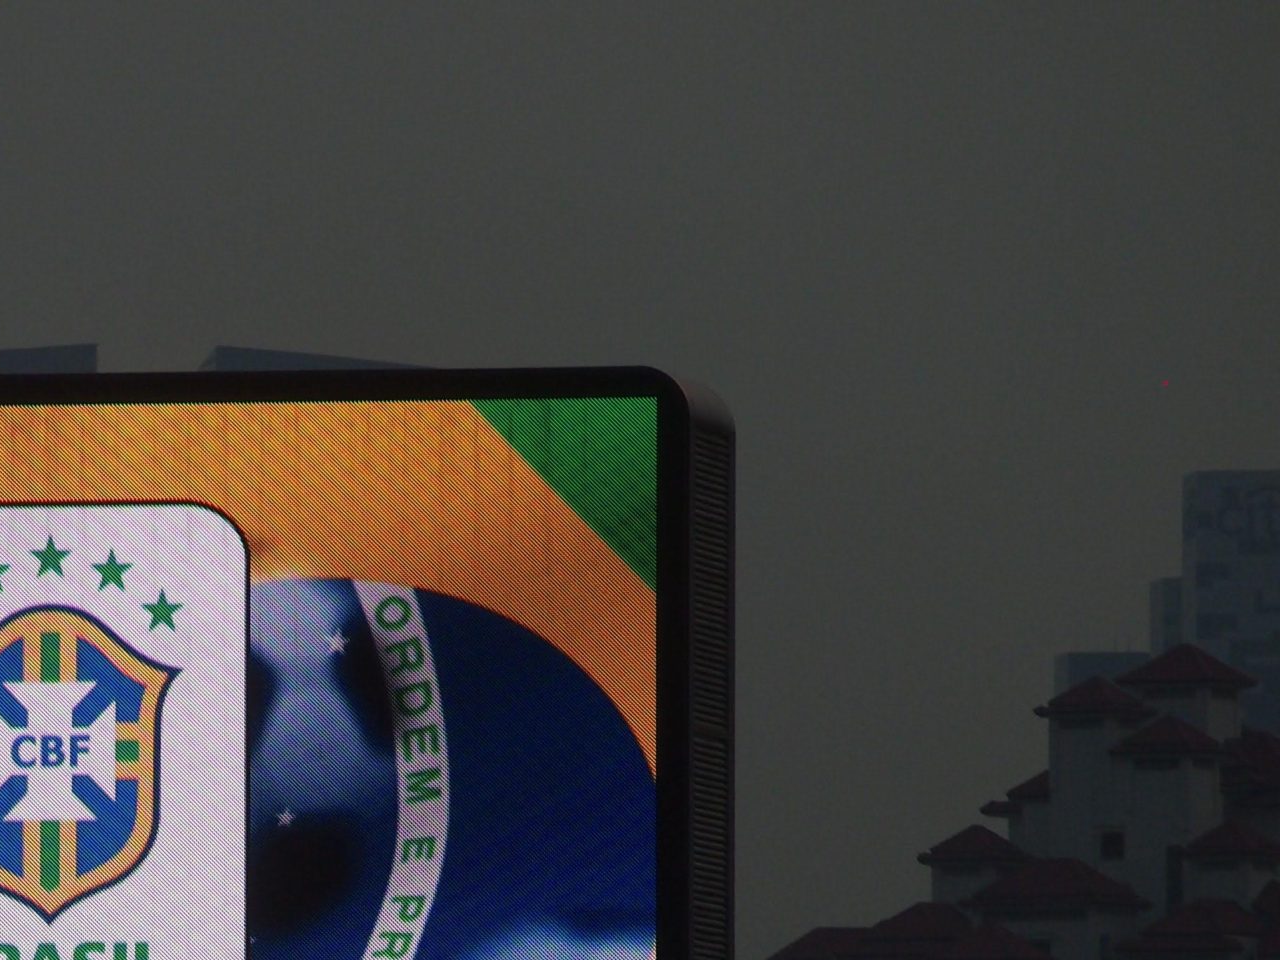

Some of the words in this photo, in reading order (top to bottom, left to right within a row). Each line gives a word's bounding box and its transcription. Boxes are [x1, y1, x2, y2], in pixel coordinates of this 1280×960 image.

[374, 596, 442, 804] ORDEM
[10, 733, 91, 768] CBF
[401, 836, 437, 865] E
